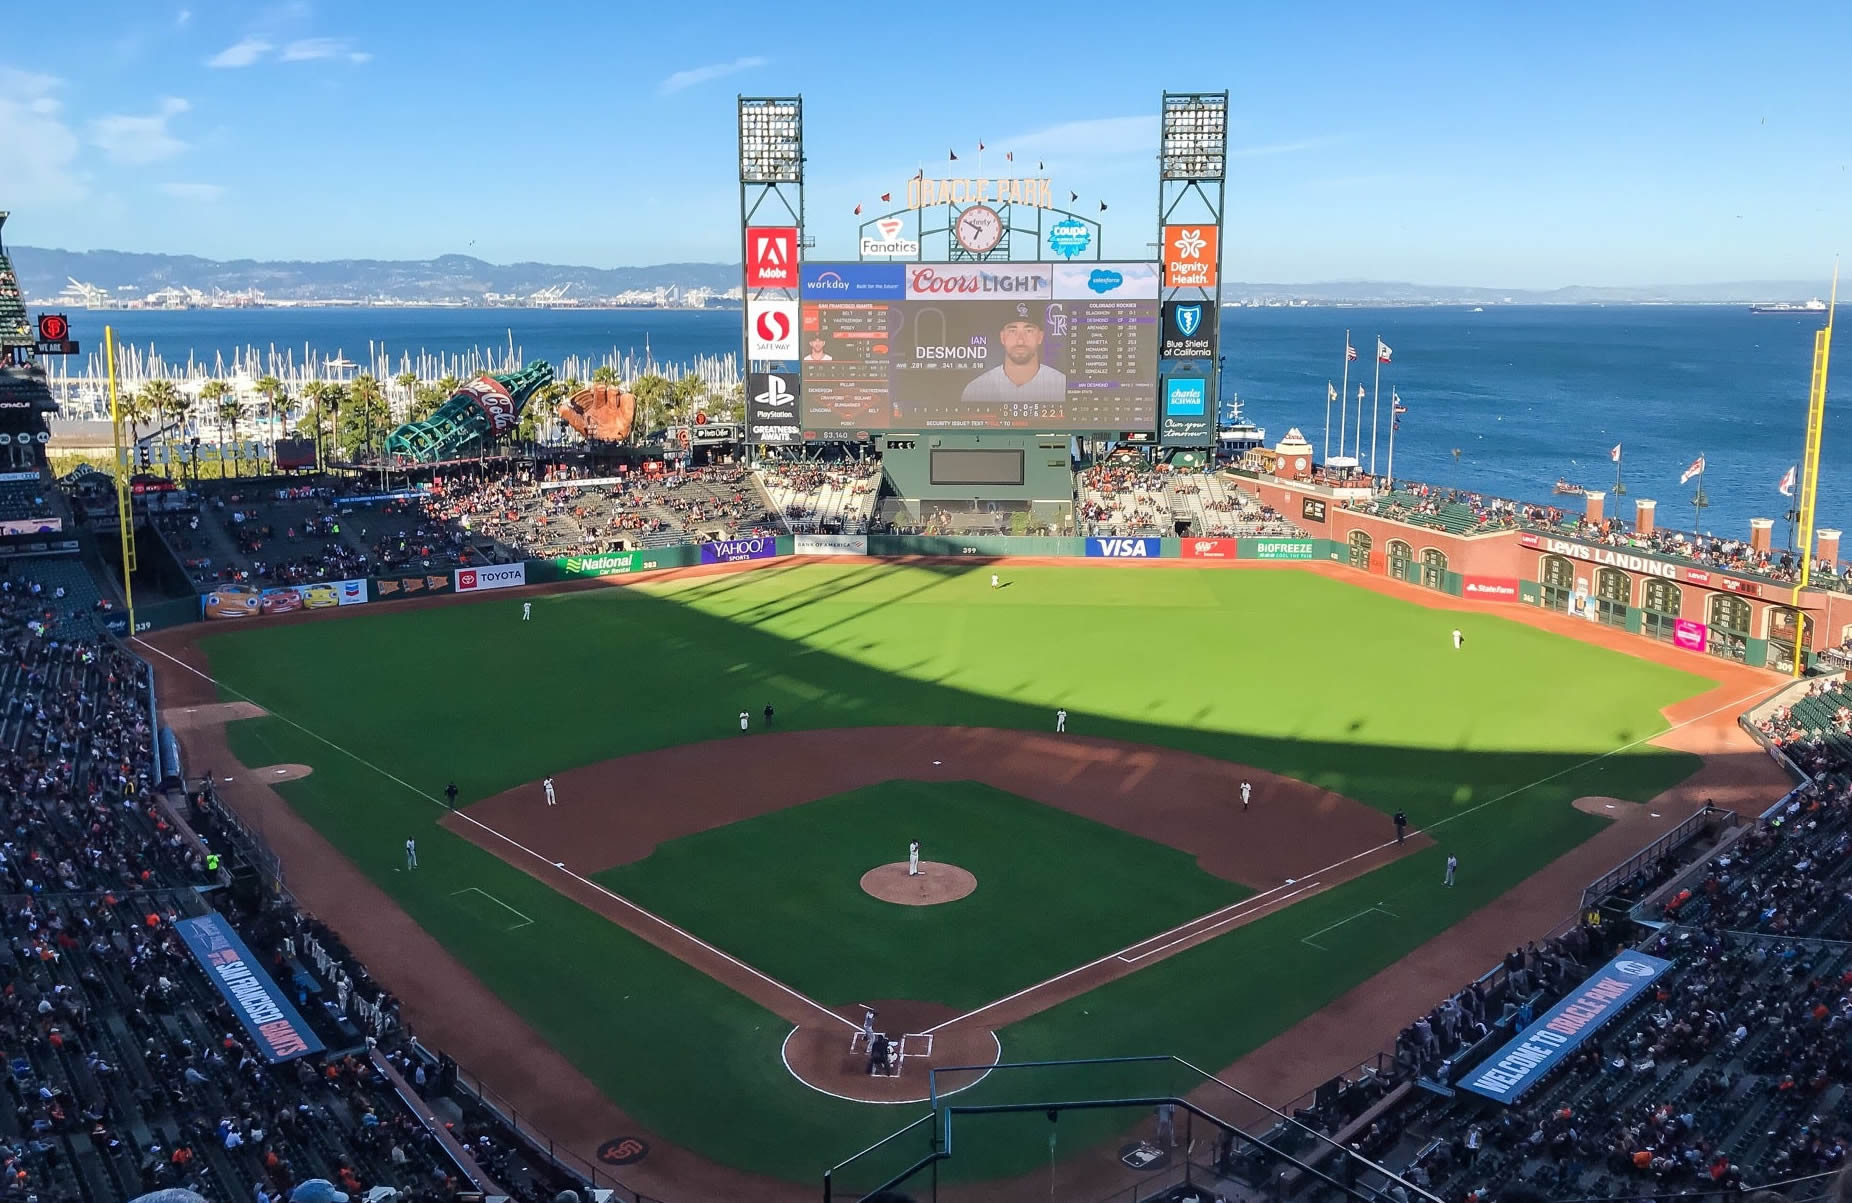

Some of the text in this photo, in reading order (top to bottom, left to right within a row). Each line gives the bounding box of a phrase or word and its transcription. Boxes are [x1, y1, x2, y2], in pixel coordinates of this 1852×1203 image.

[908, 179, 1053, 210] ORACLE PARK
[1054, 226, 1087, 239] coupa
[863, 241, 917, 253] Fanatics
[758, 267, 787, 279] Adobe
[1171, 262, 1208, 274] Dignity
[807, 280, 849, 291] workday
[912, 268, 1041, 293] Coors LIGHT
[1093, 277, 1120, 285] salesforce
[971, 336, 987, 345] IAN
[1166, 340, 1209, 348] Blue Shield
[916, 346, 987, 358] DESMOND
[1164, 348, 1211, 356] of California
[1171, 388, 1200, 398] charles
[1170, 397, 1201, 405] SCHWAB
[1184, 421, 1207, 432] your
[714, 539, 764, 557] YAHOO!
[1097, 539, 1147, 556] VISA
[581, 554, 633, 571] National
[728, 554, 750, 562] SPORTS
[1594, 549, 1676, 579] LANDING
[480, 570, 522, 583] TOYOTA
[611, 567, 631, 575] Rental
[135, 621, 151, 631] 339
[1776, 661, 1794, 673] 309
[215, 960, 252, 986] SAN
[229, 976, 284, 1025] FRANCISCO
[258, 1019, 308, 1056] GIANTS
[1473, 977, 1632, 1094] WELCOME TO ORACLE PARK
